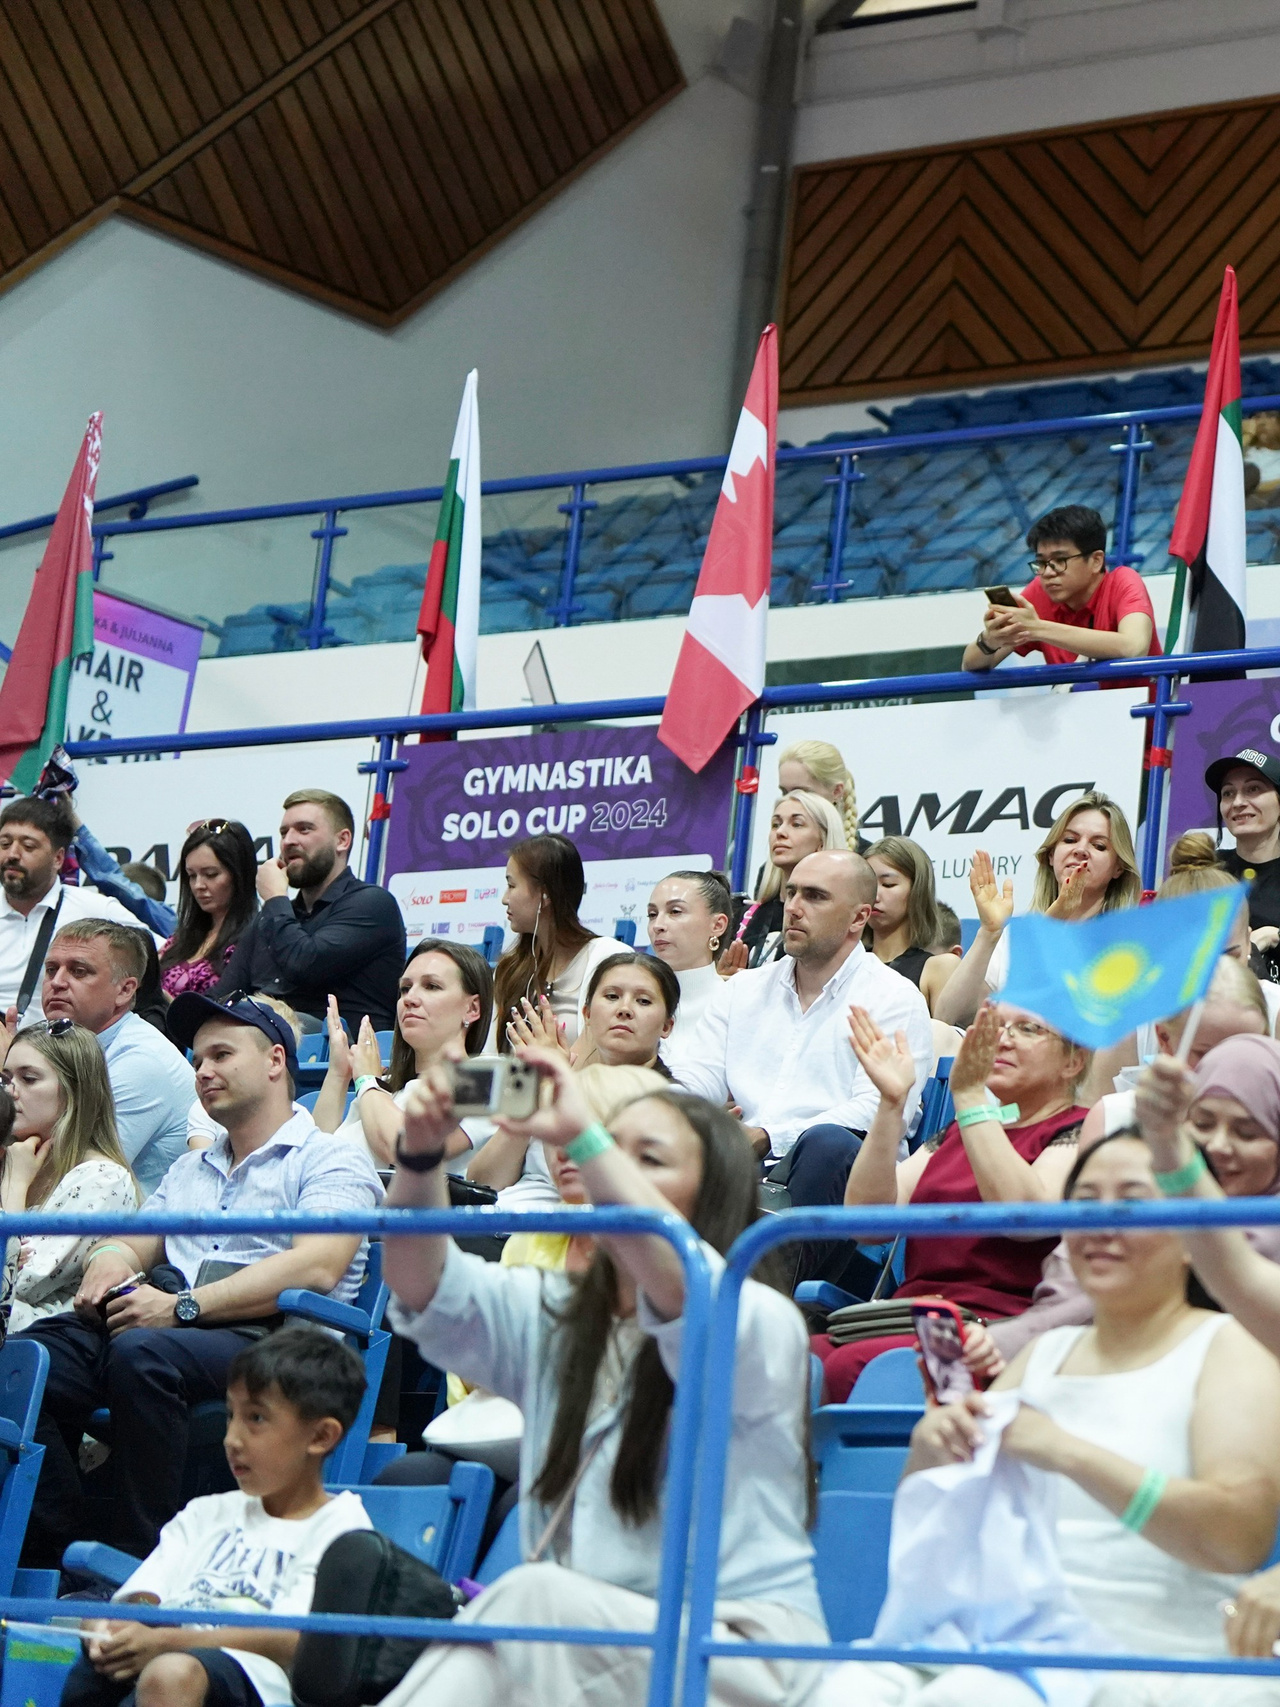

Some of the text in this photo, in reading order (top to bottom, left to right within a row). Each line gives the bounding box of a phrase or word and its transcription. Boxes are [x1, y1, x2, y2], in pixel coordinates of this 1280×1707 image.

[119, 627, 174, 653] JULIANNA
[75, 650, 144, 693] HAIR
[91, 690, 112, 725] &
[463, 755, 652, 796] GYMNASTIKA
[441, 798, 667, 842] SOLO CUP 2024
[411, 895, 433, 905] SOLO
